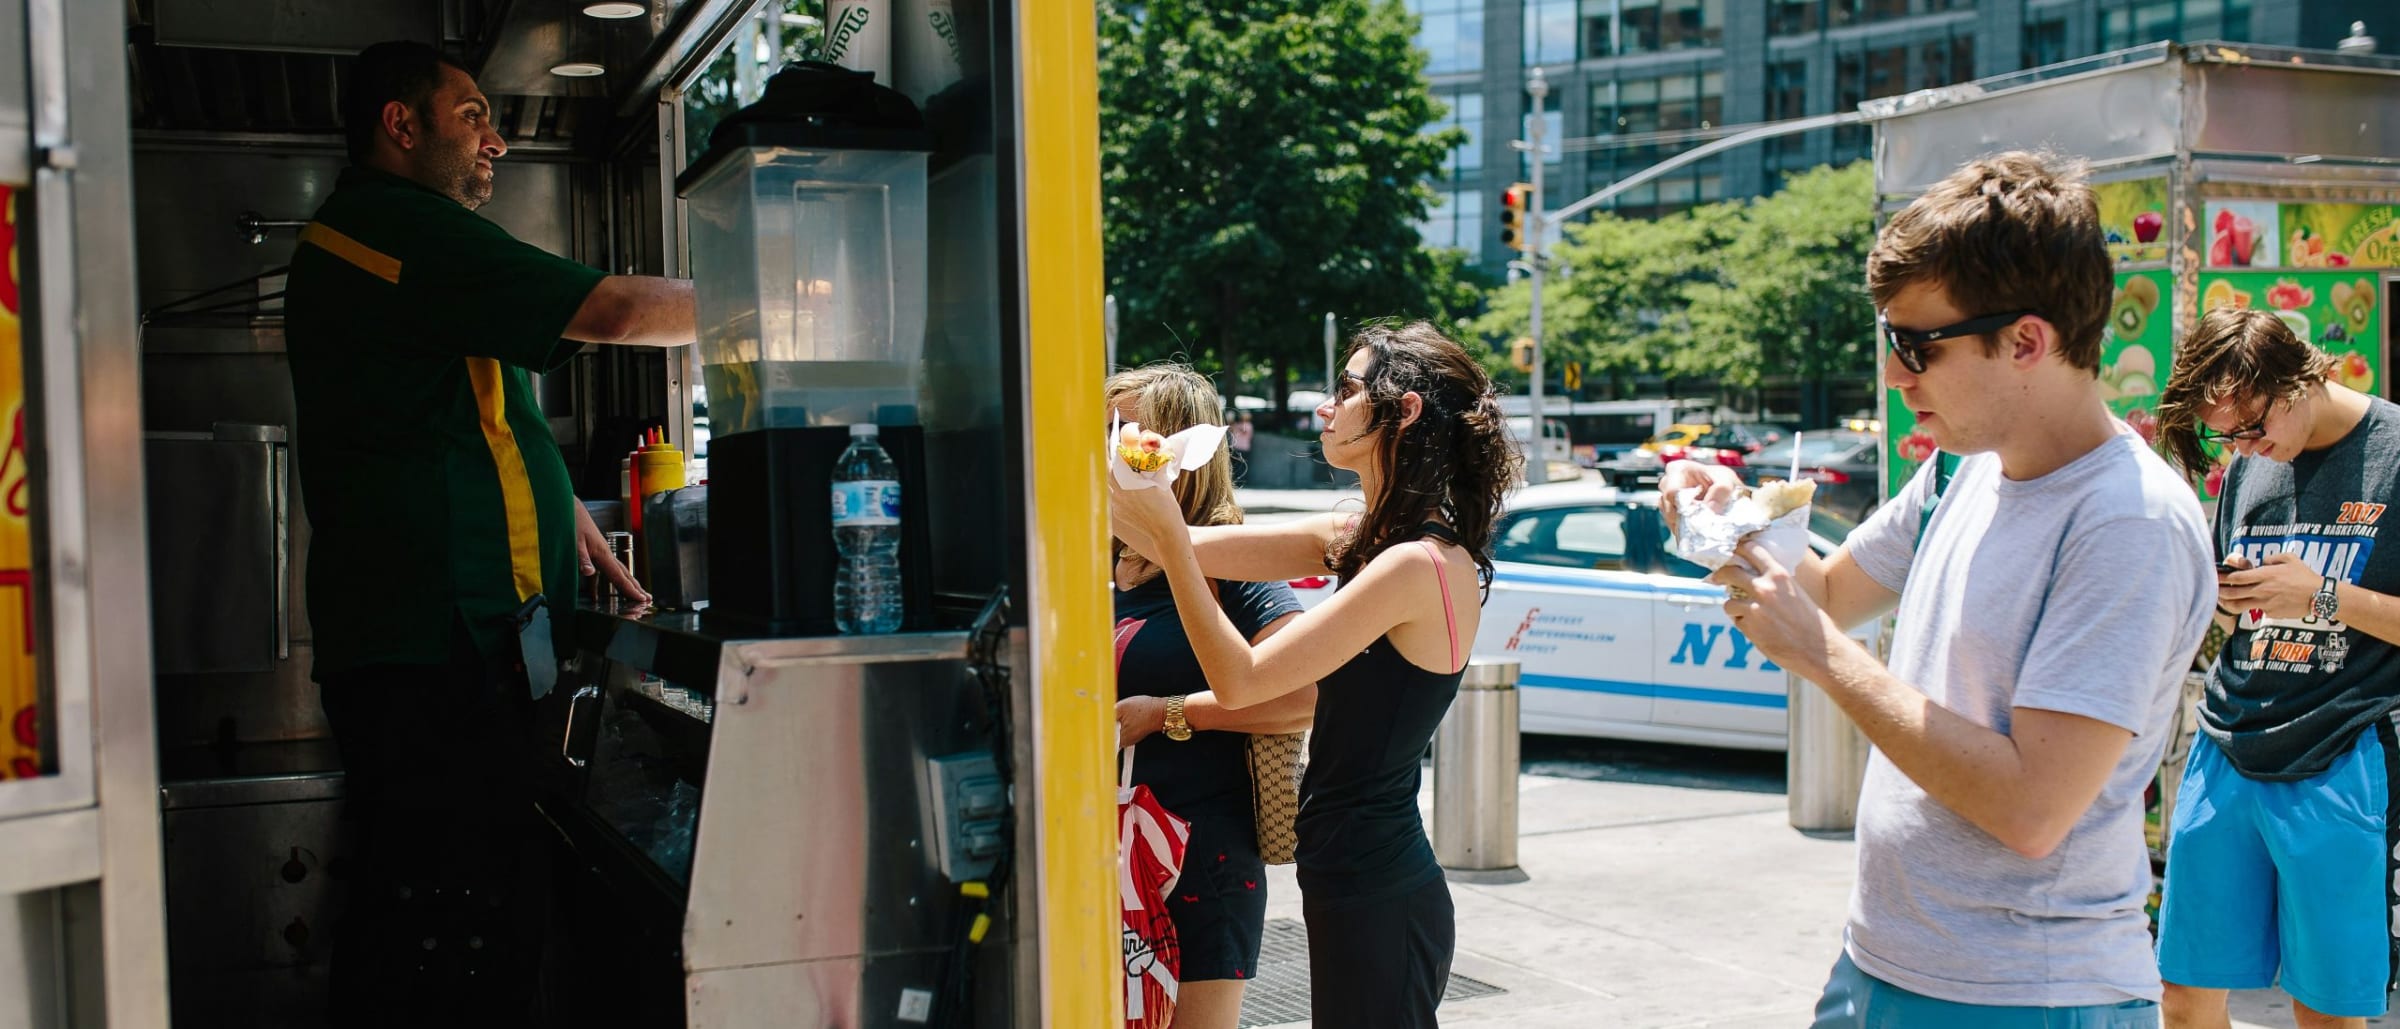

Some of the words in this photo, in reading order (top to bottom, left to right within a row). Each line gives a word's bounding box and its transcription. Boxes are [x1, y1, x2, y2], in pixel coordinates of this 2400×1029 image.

[2336, 502, 2387, 525] 2017
[2251, 525, 2288, 537] DIVISION
[2323, 525, 2379, 538] BASKETBALL
[1669, 623, 1781, 671] NY
[2268, 640, 2316, 663] YORK
